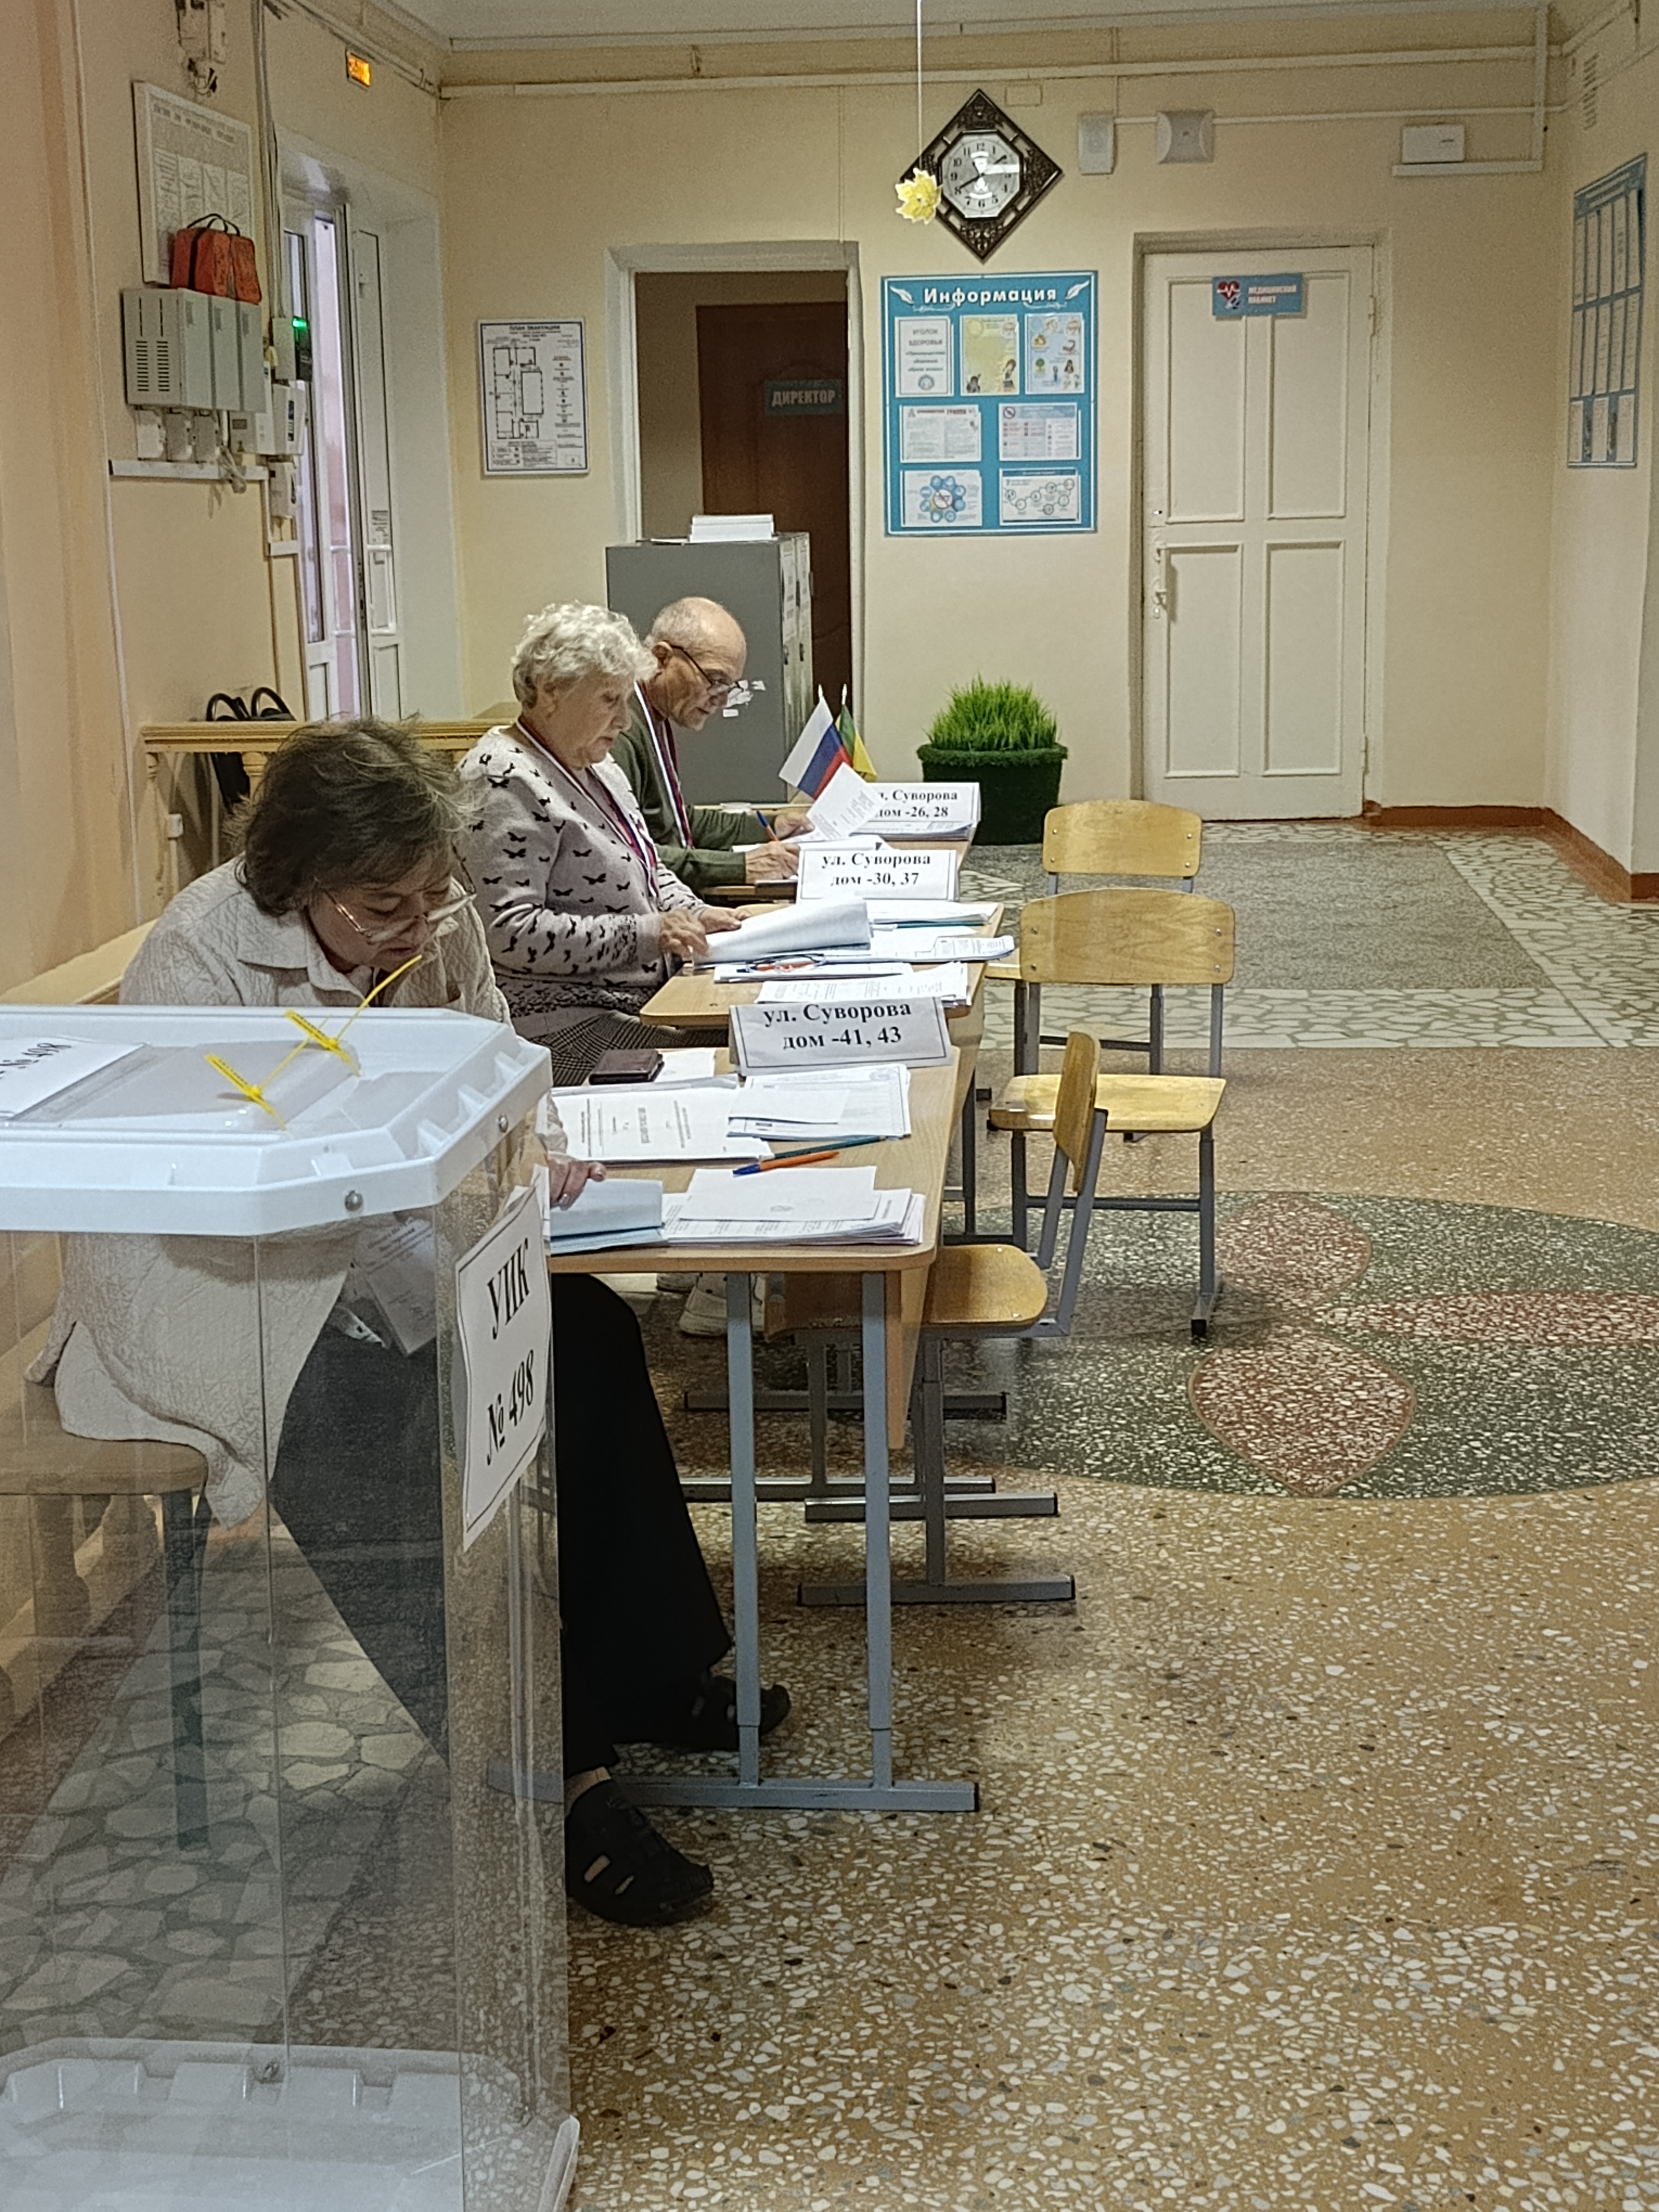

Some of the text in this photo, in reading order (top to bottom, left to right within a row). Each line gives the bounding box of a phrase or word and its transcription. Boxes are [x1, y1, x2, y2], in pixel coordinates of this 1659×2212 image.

[963, 146, 970, 156] 11
[976, 143, 985, 151] 12
[992, 145, 996, 155] 1
[953, 158, 962, 167] 10
[950, 172, 957, 181] 9
[964, 196, 971, 205] 7
[924, 287, 1056, 307] Информация
[771, 389, 836, 408] ДИРЕКТОР
[893, 789, 958, 804] Суворова
[933, 806, 949, 818] 28
[821, 852, 931, 869] ул. Суворова
[830, 876, 861, 887] дом
[900, 872, 919, 886] 37
[763, 1004, 912, 1028] ул. Суворова
[783, 1035, 825, 1050] дом
[877, 1026, 902, 1044] 43
[487, 1237, 530, 1341] УИК
[509, 1349, 534, 1427] 498
